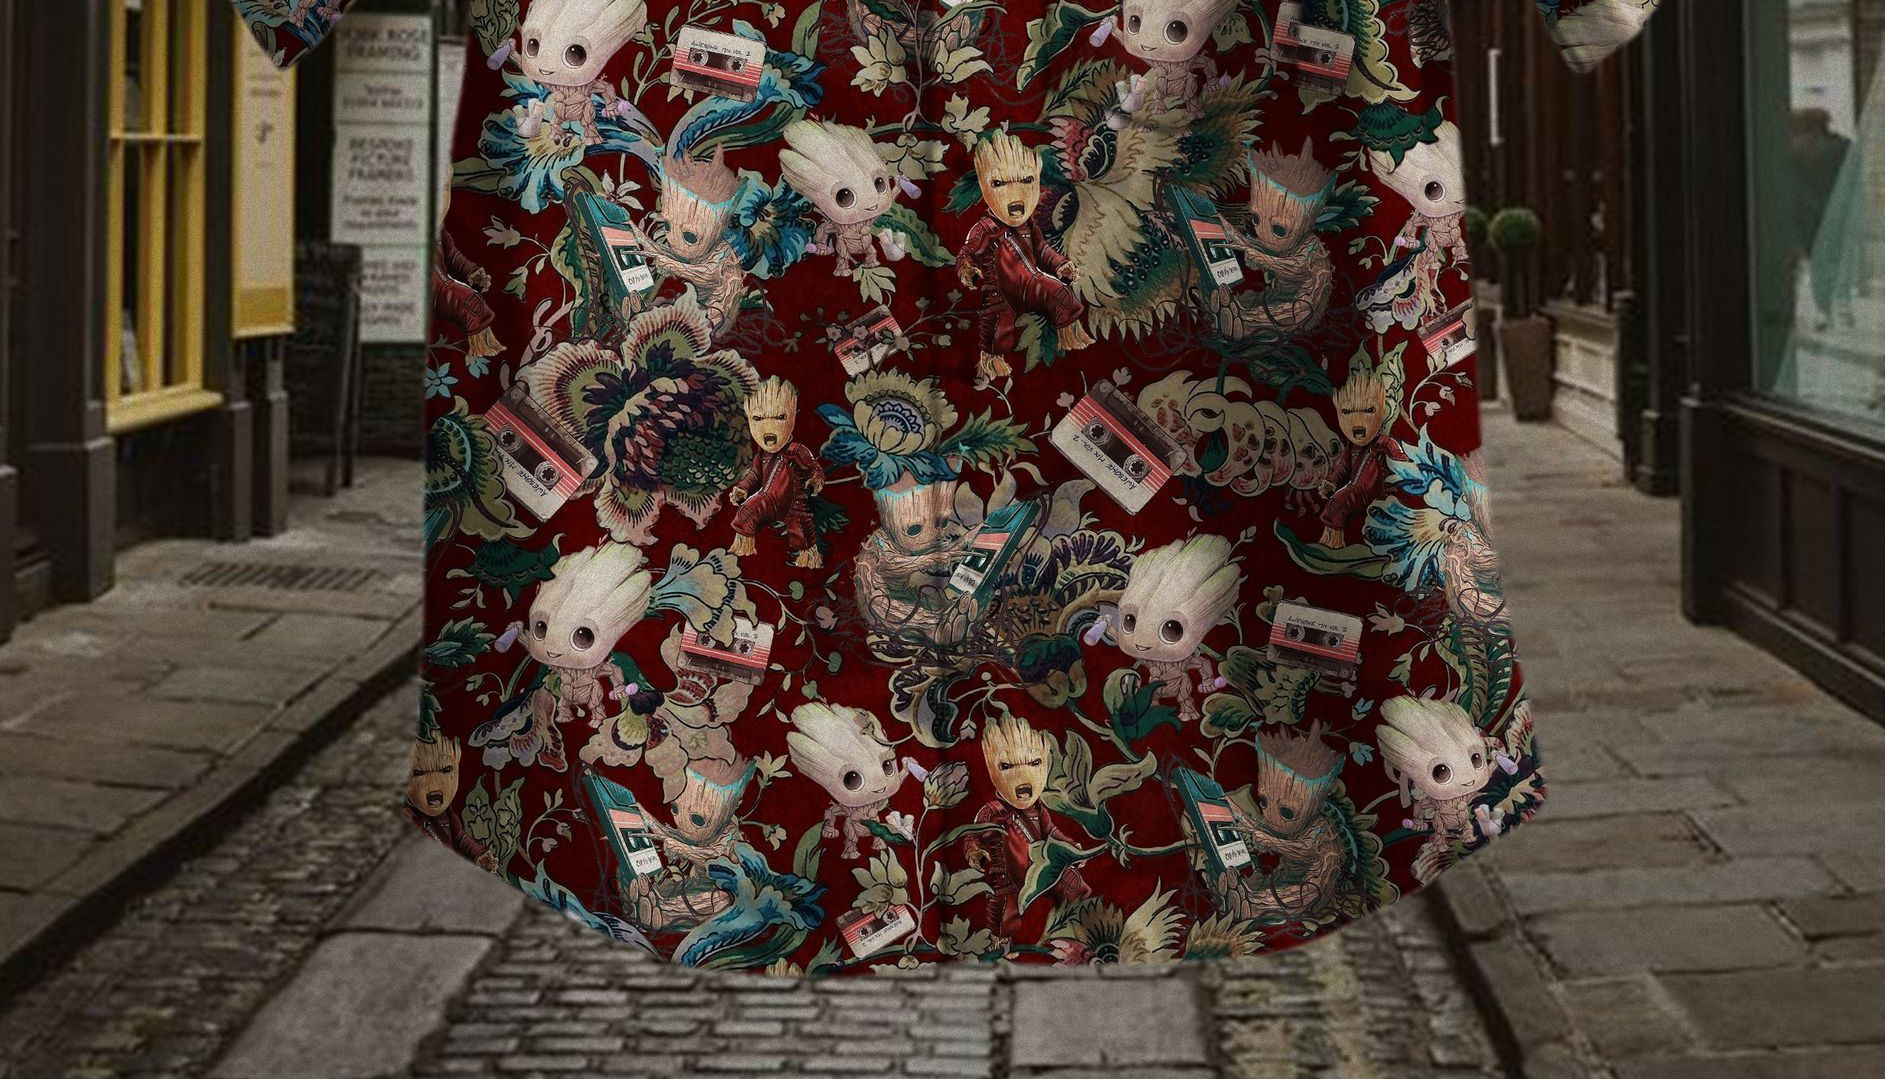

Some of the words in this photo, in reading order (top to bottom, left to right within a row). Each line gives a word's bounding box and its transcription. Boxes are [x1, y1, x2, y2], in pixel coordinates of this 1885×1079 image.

[1070, 433, 1080, 443] 2
[515, 468, 548, 498] AWESOME
[1103, 461, 1138, 492] AWESOME
